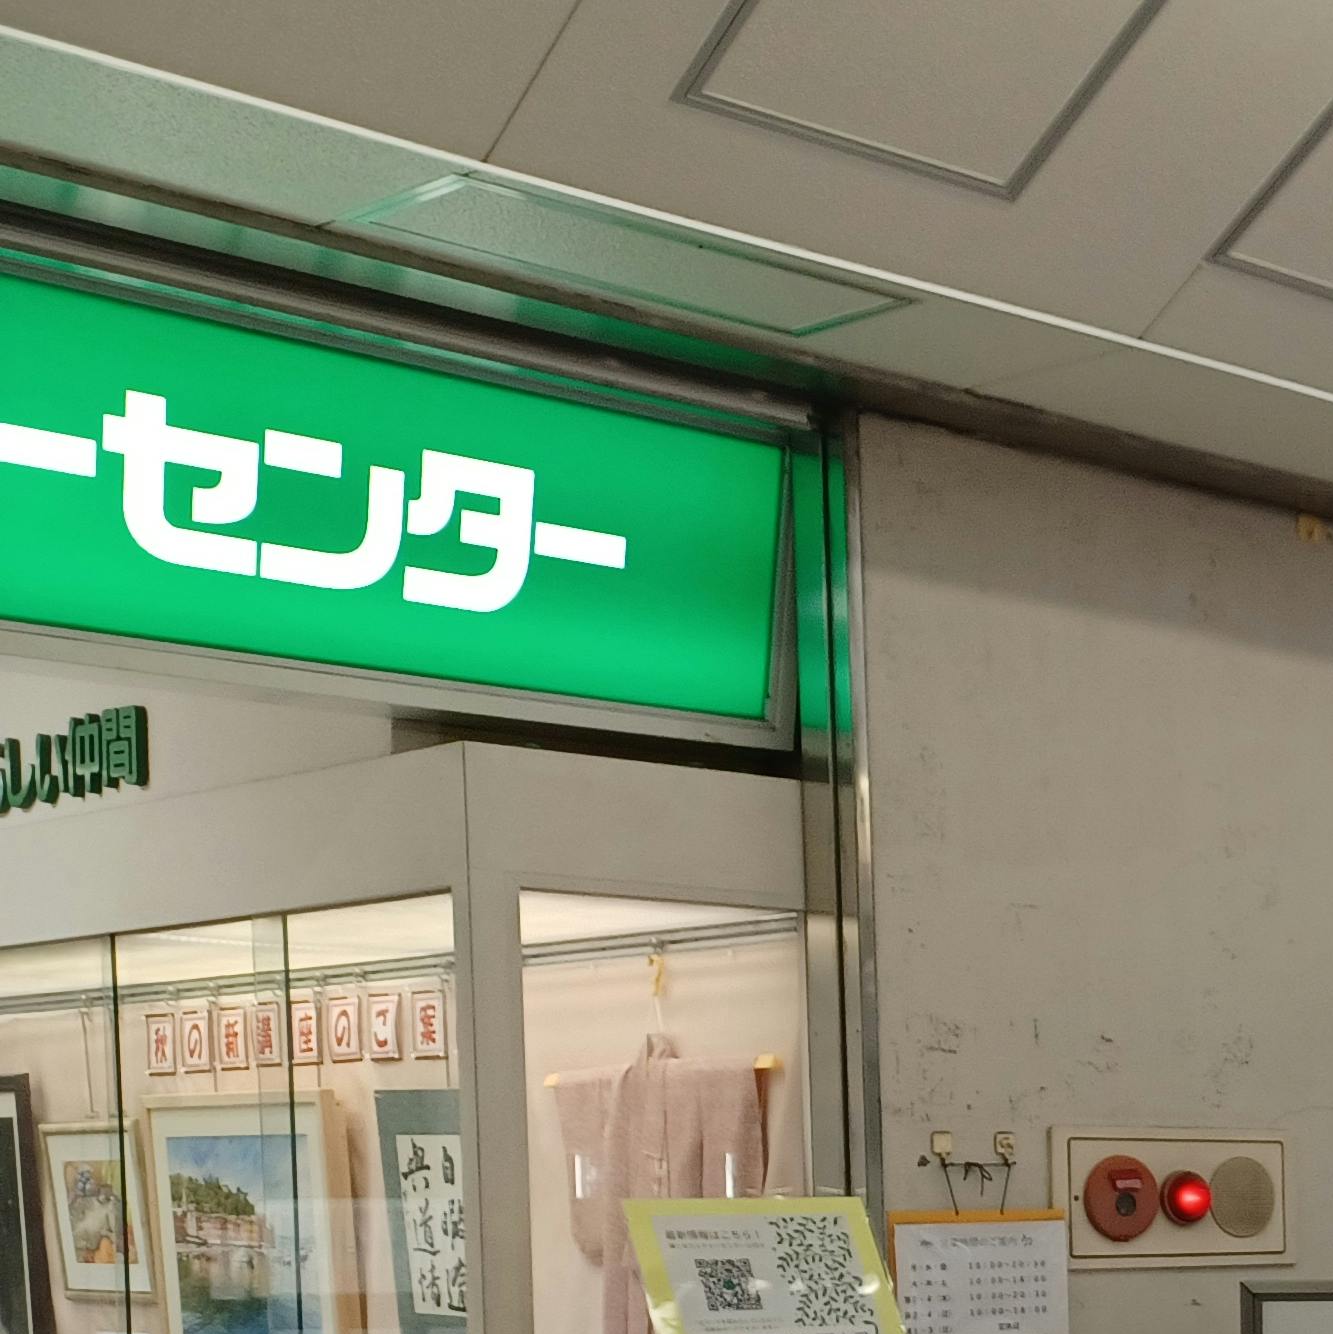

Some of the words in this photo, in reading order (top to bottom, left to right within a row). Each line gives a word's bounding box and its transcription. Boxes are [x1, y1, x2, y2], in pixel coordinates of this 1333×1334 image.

[0, 389, 626, 613] ーセンター
